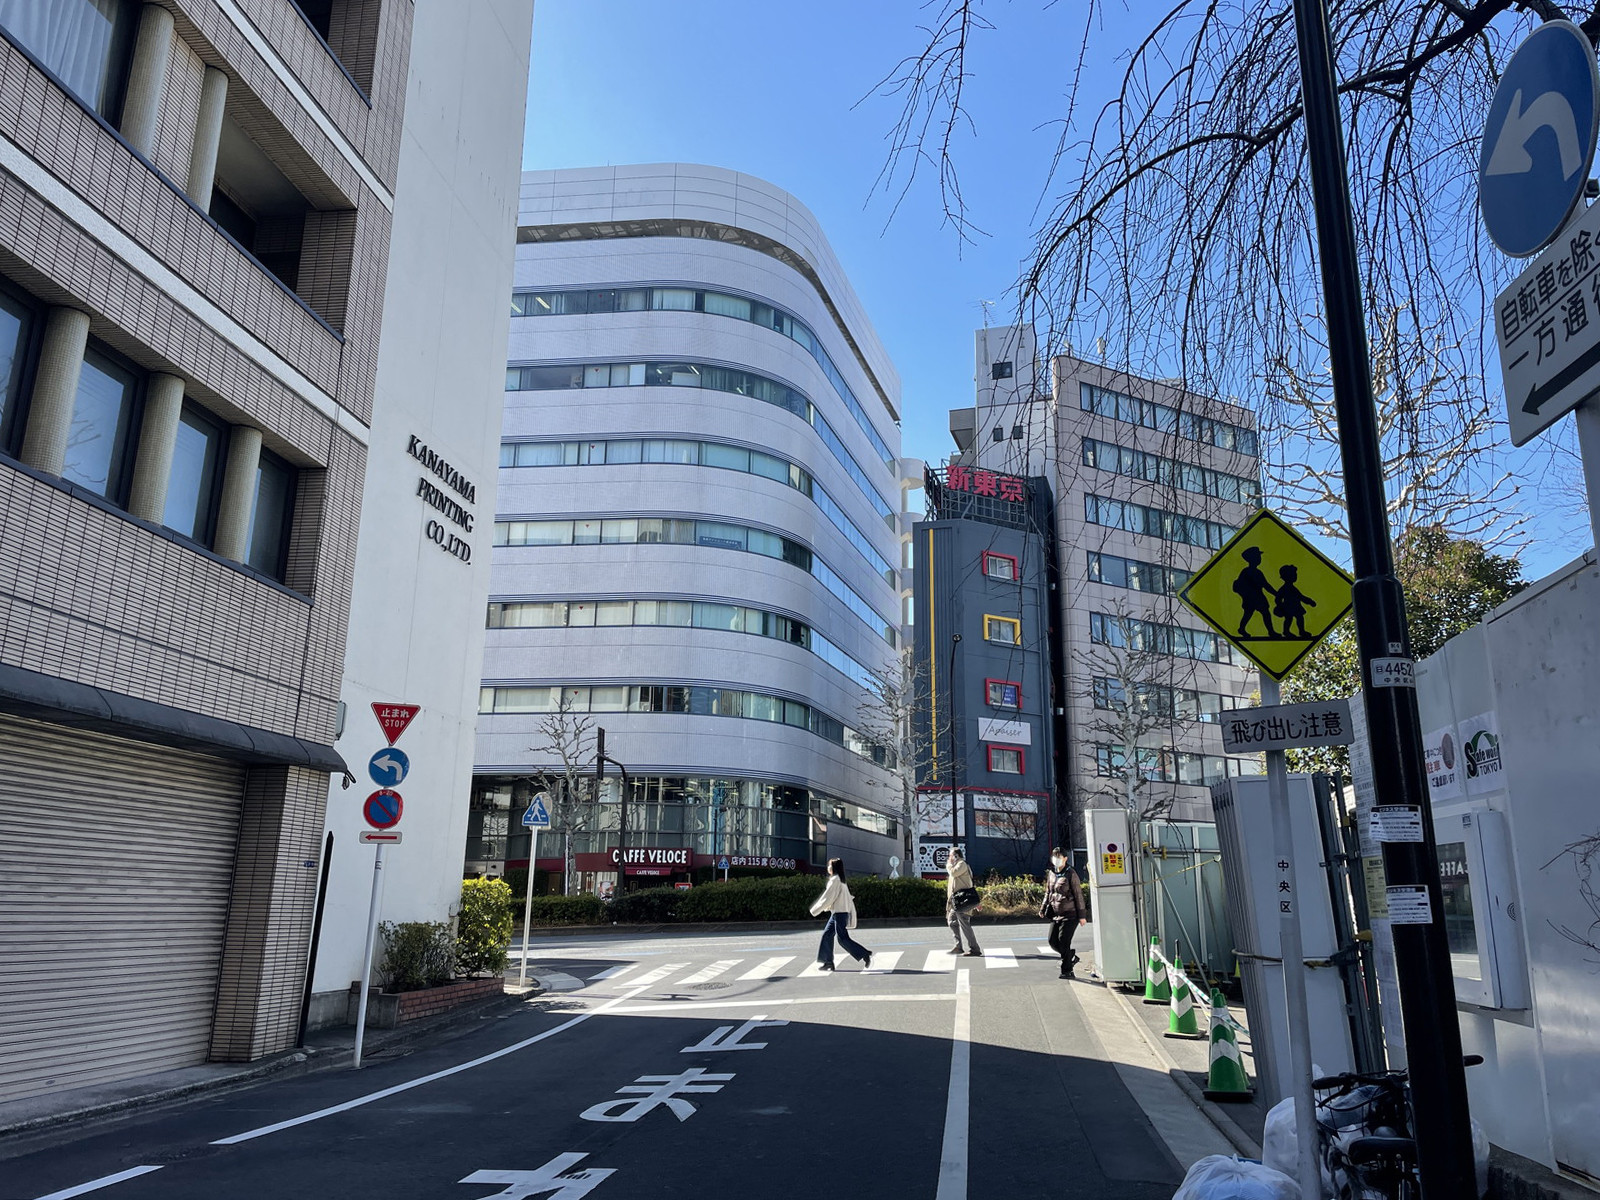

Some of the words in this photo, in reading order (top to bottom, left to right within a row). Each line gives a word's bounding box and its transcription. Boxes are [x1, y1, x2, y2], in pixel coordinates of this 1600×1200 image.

[407, 434, 477, 505] KANAYAMA
[946, 465, 1025, 502] 新東京
[416, 476, 474, 533] PRINTING
[381, 708, 409, 718] 止まれ
[384, 718, 405, 728] STOP
[1230, 712, 1343, 744] 飛び出し注意
[1479, 762, 1498, 775] TOKYO
[648, 849, 687, 864] VELOCE
[1277, 860, 1292, 913] 中央区
